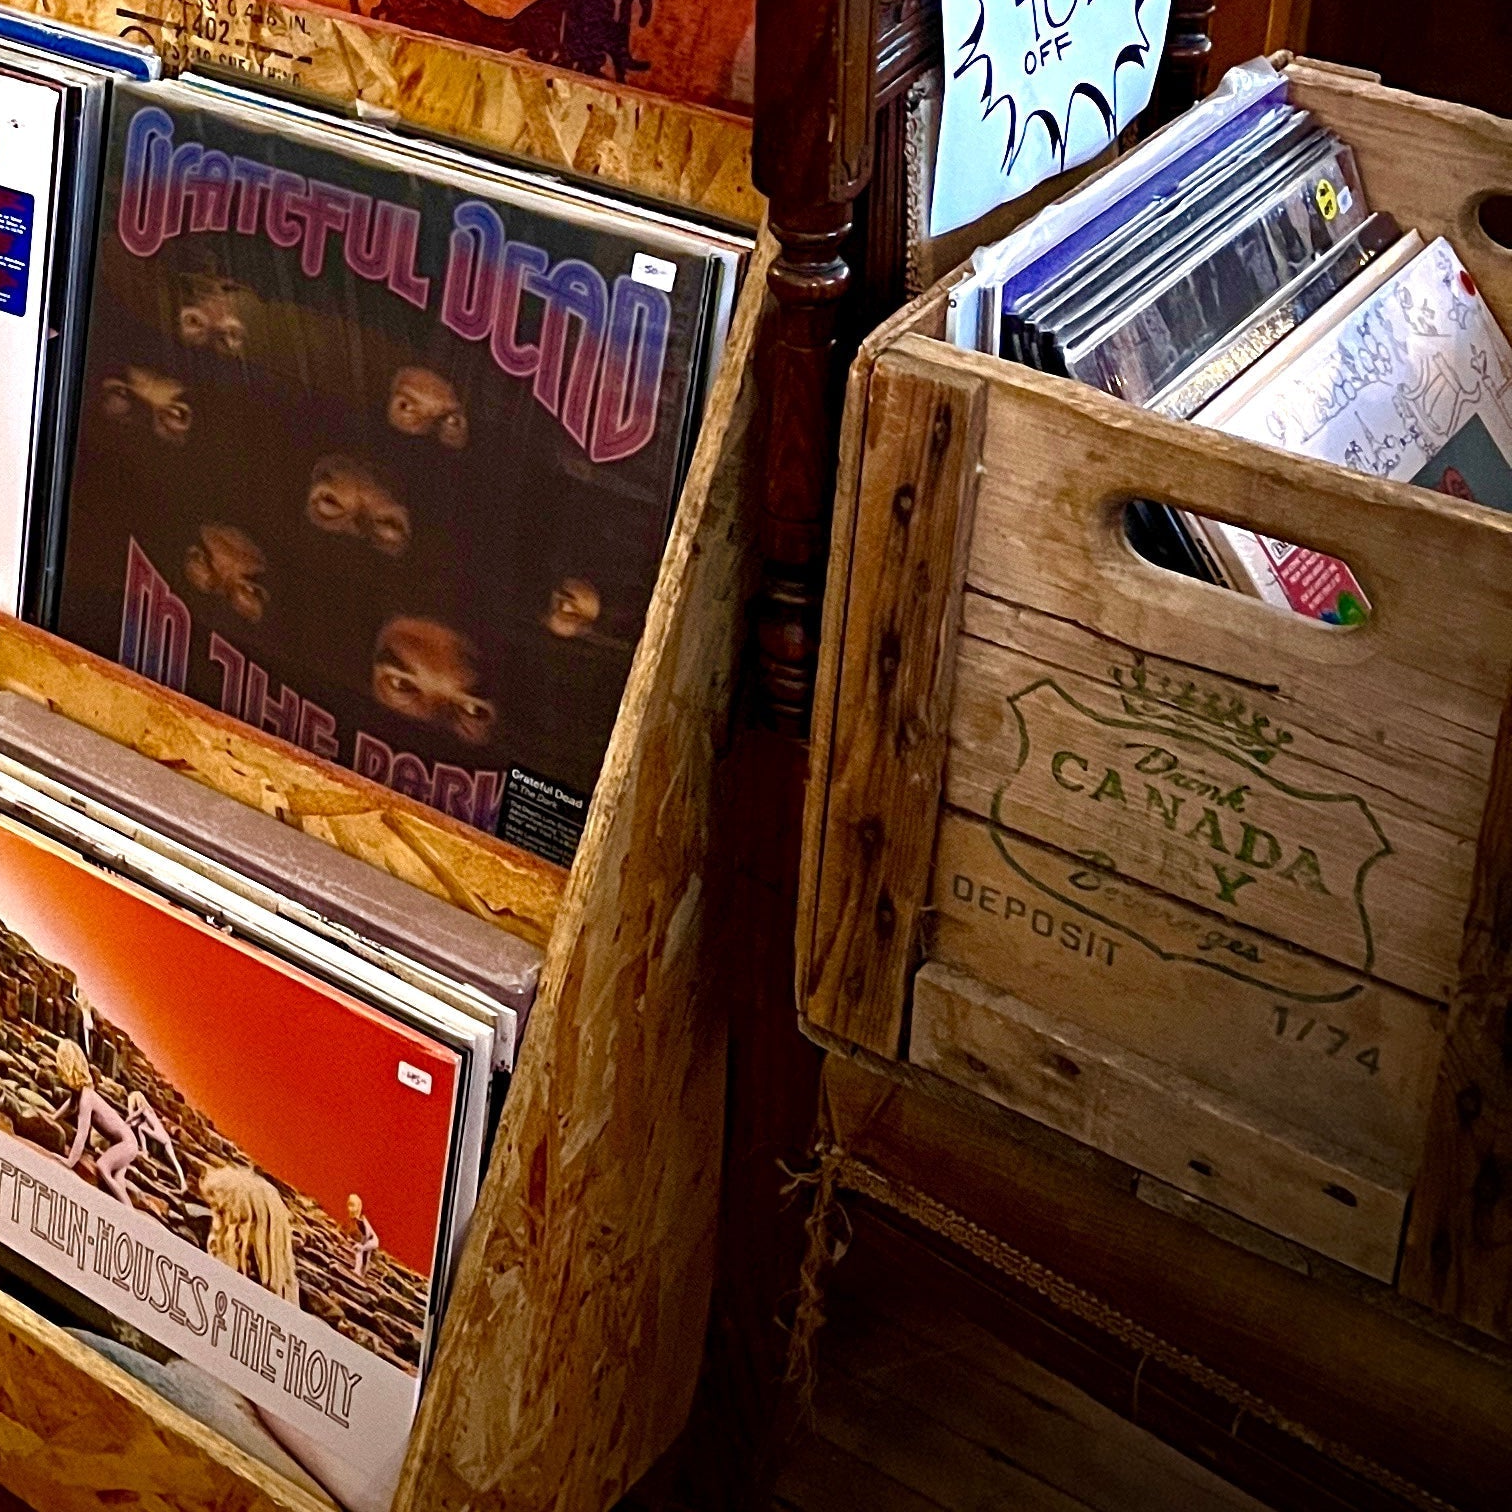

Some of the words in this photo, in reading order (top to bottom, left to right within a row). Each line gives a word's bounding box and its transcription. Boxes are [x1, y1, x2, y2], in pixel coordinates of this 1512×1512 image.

[1023, 32, 1075, 76] OFF
[117, 105, 433, 310] GRATEFUL
[441, 198, 673, 463] DEAD
[208, 633, 339, 761] THE
[511, 768, 554, 796] Grateful
[554, 788, 584, 809] Dead
[520, 784, 536, 800] The
[536, 792, 558, 809] Dark
[1124, 742, 1252, 814] Drink
[1050, 750, 1332, 898] CANADA
[952, 874, 1123, 967] DEPOSIT
[1273, 1005, 1381, 1076] 1/74
[282, 1334, 363, 1430] HOLY
